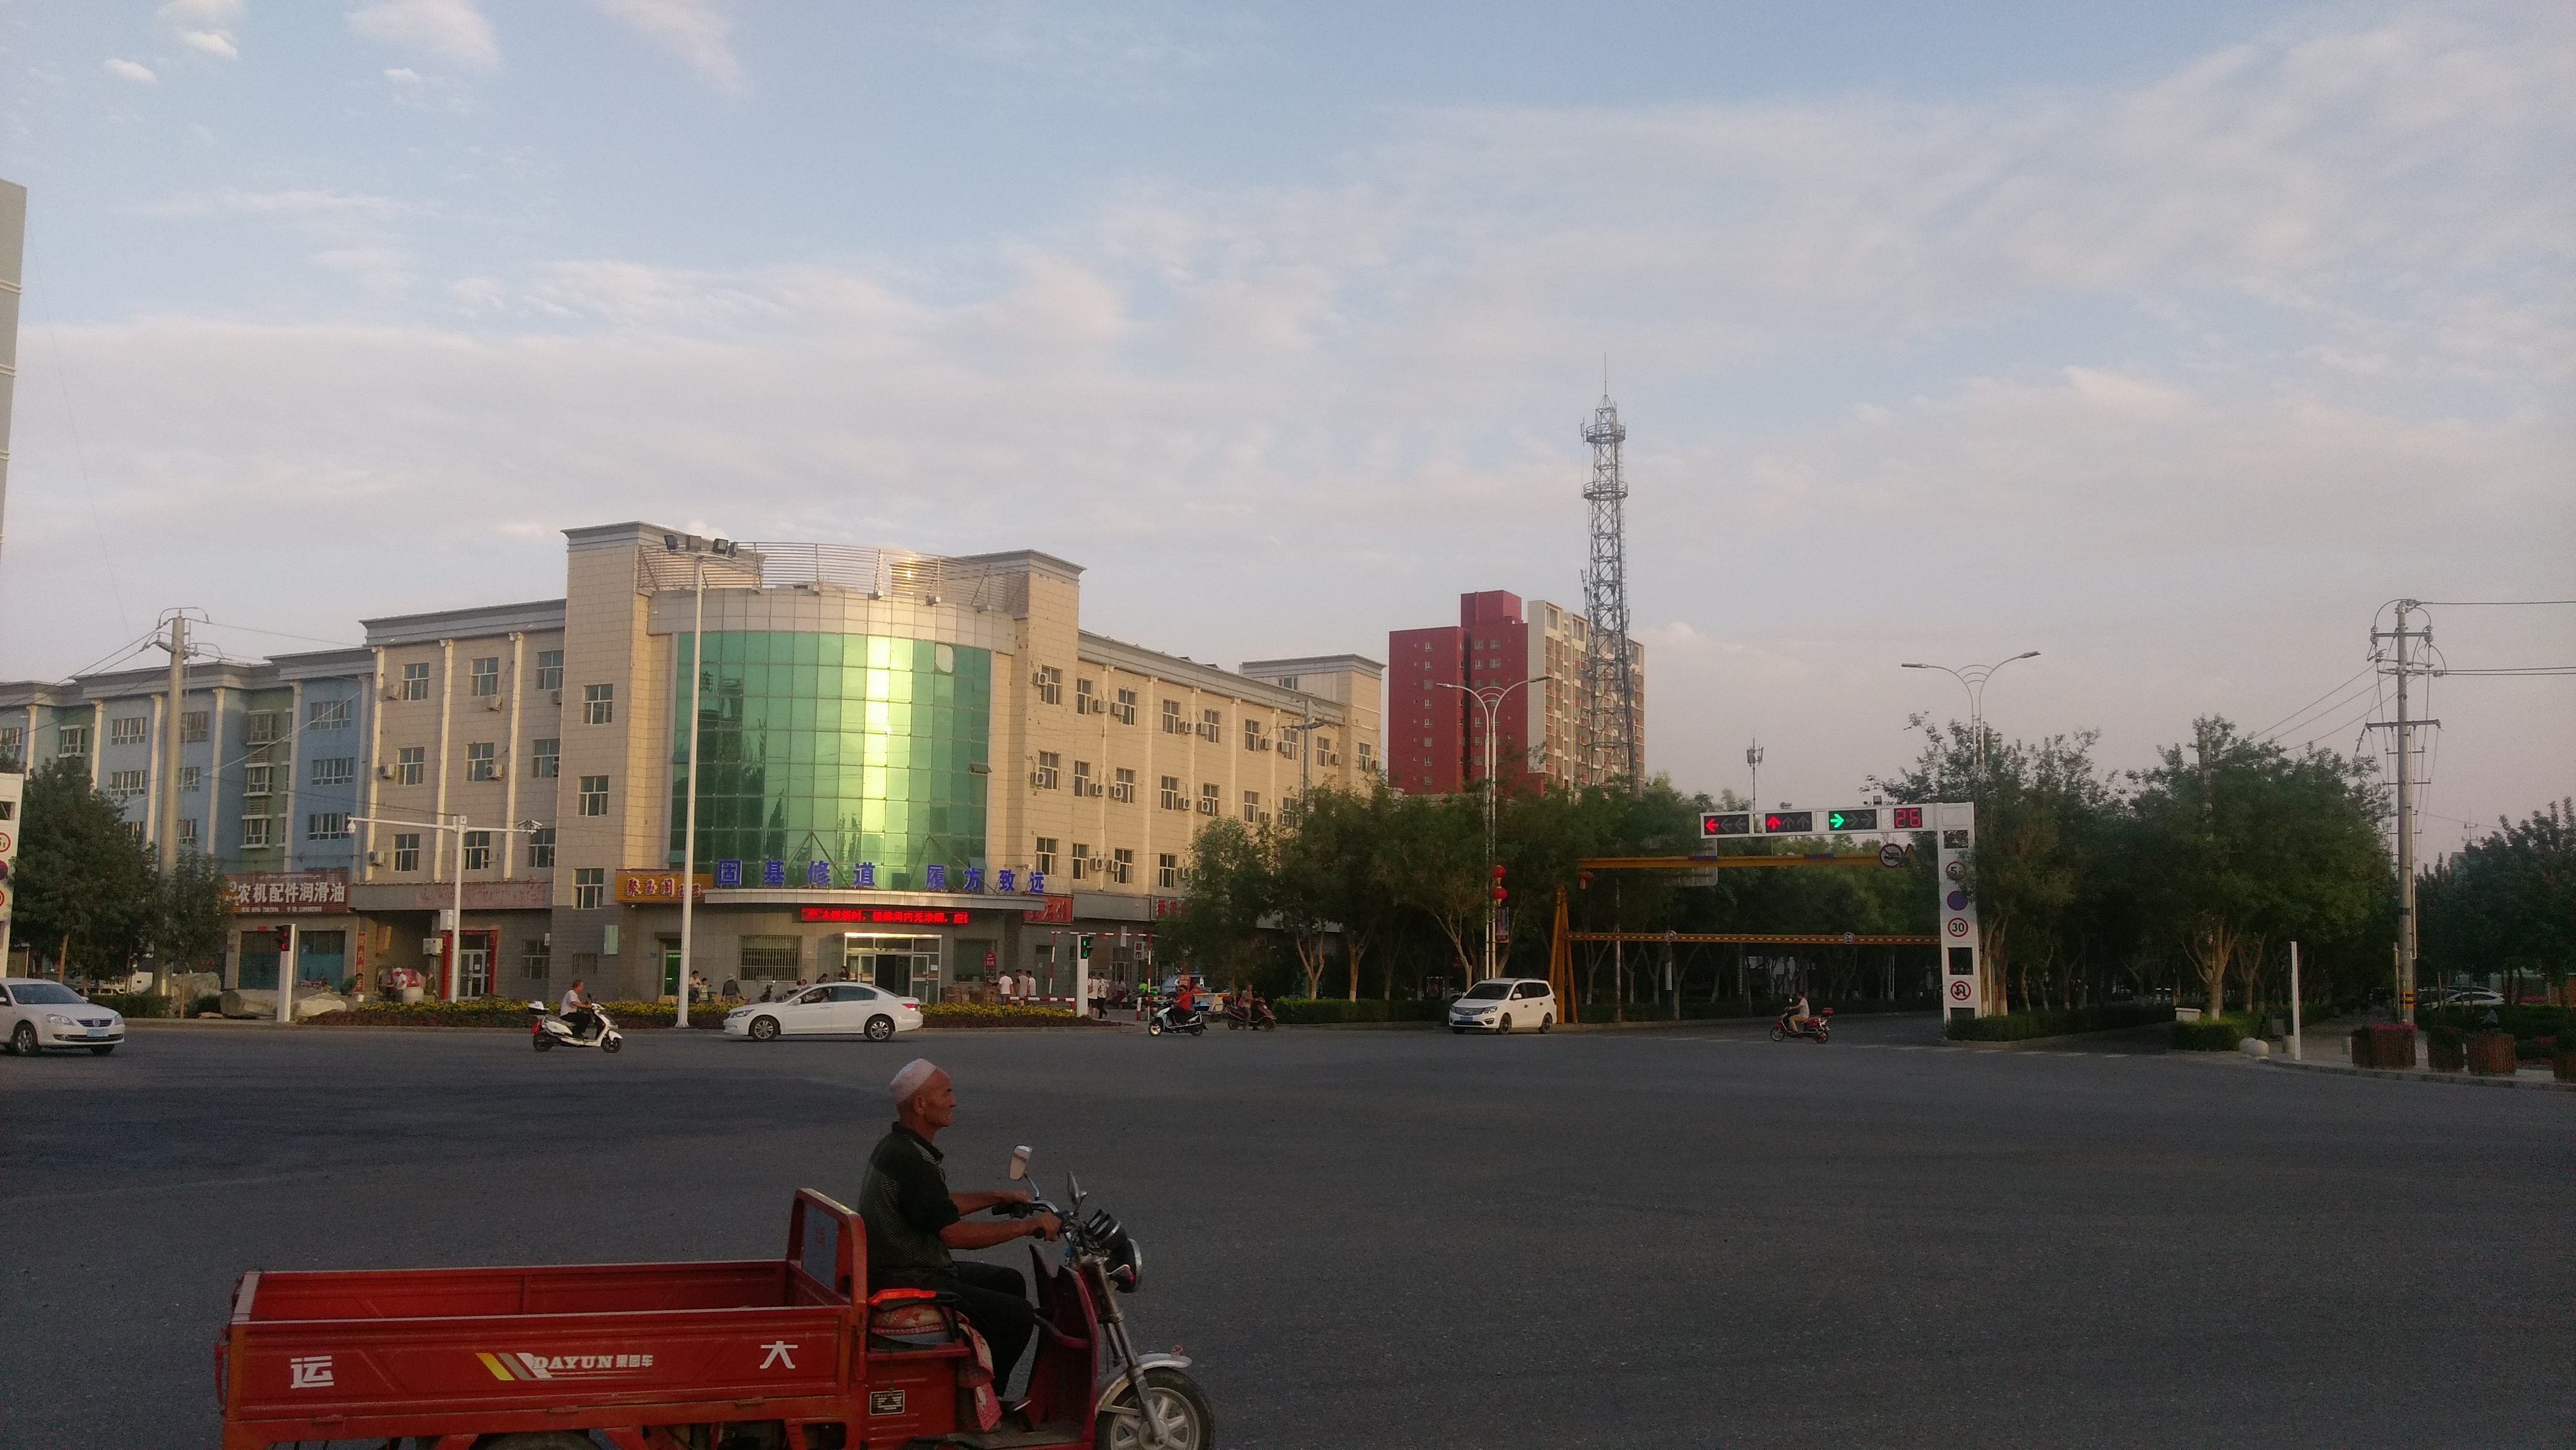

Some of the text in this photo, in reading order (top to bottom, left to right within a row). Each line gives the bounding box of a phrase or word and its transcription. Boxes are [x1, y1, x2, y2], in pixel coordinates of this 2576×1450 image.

[1895, 808, 1922, 827] 26
[717, 858, 1045, 894] 固基修道 履方致远
[238, 882, 345, 903] 农机配件润滑油
[1952, 922, 1964, 932] 30
[533, 1354, 654, 1370] DAYUN 果园车
[760, 1340, 798, 1369] 大
[290, 1356, 335, 1389] 运
